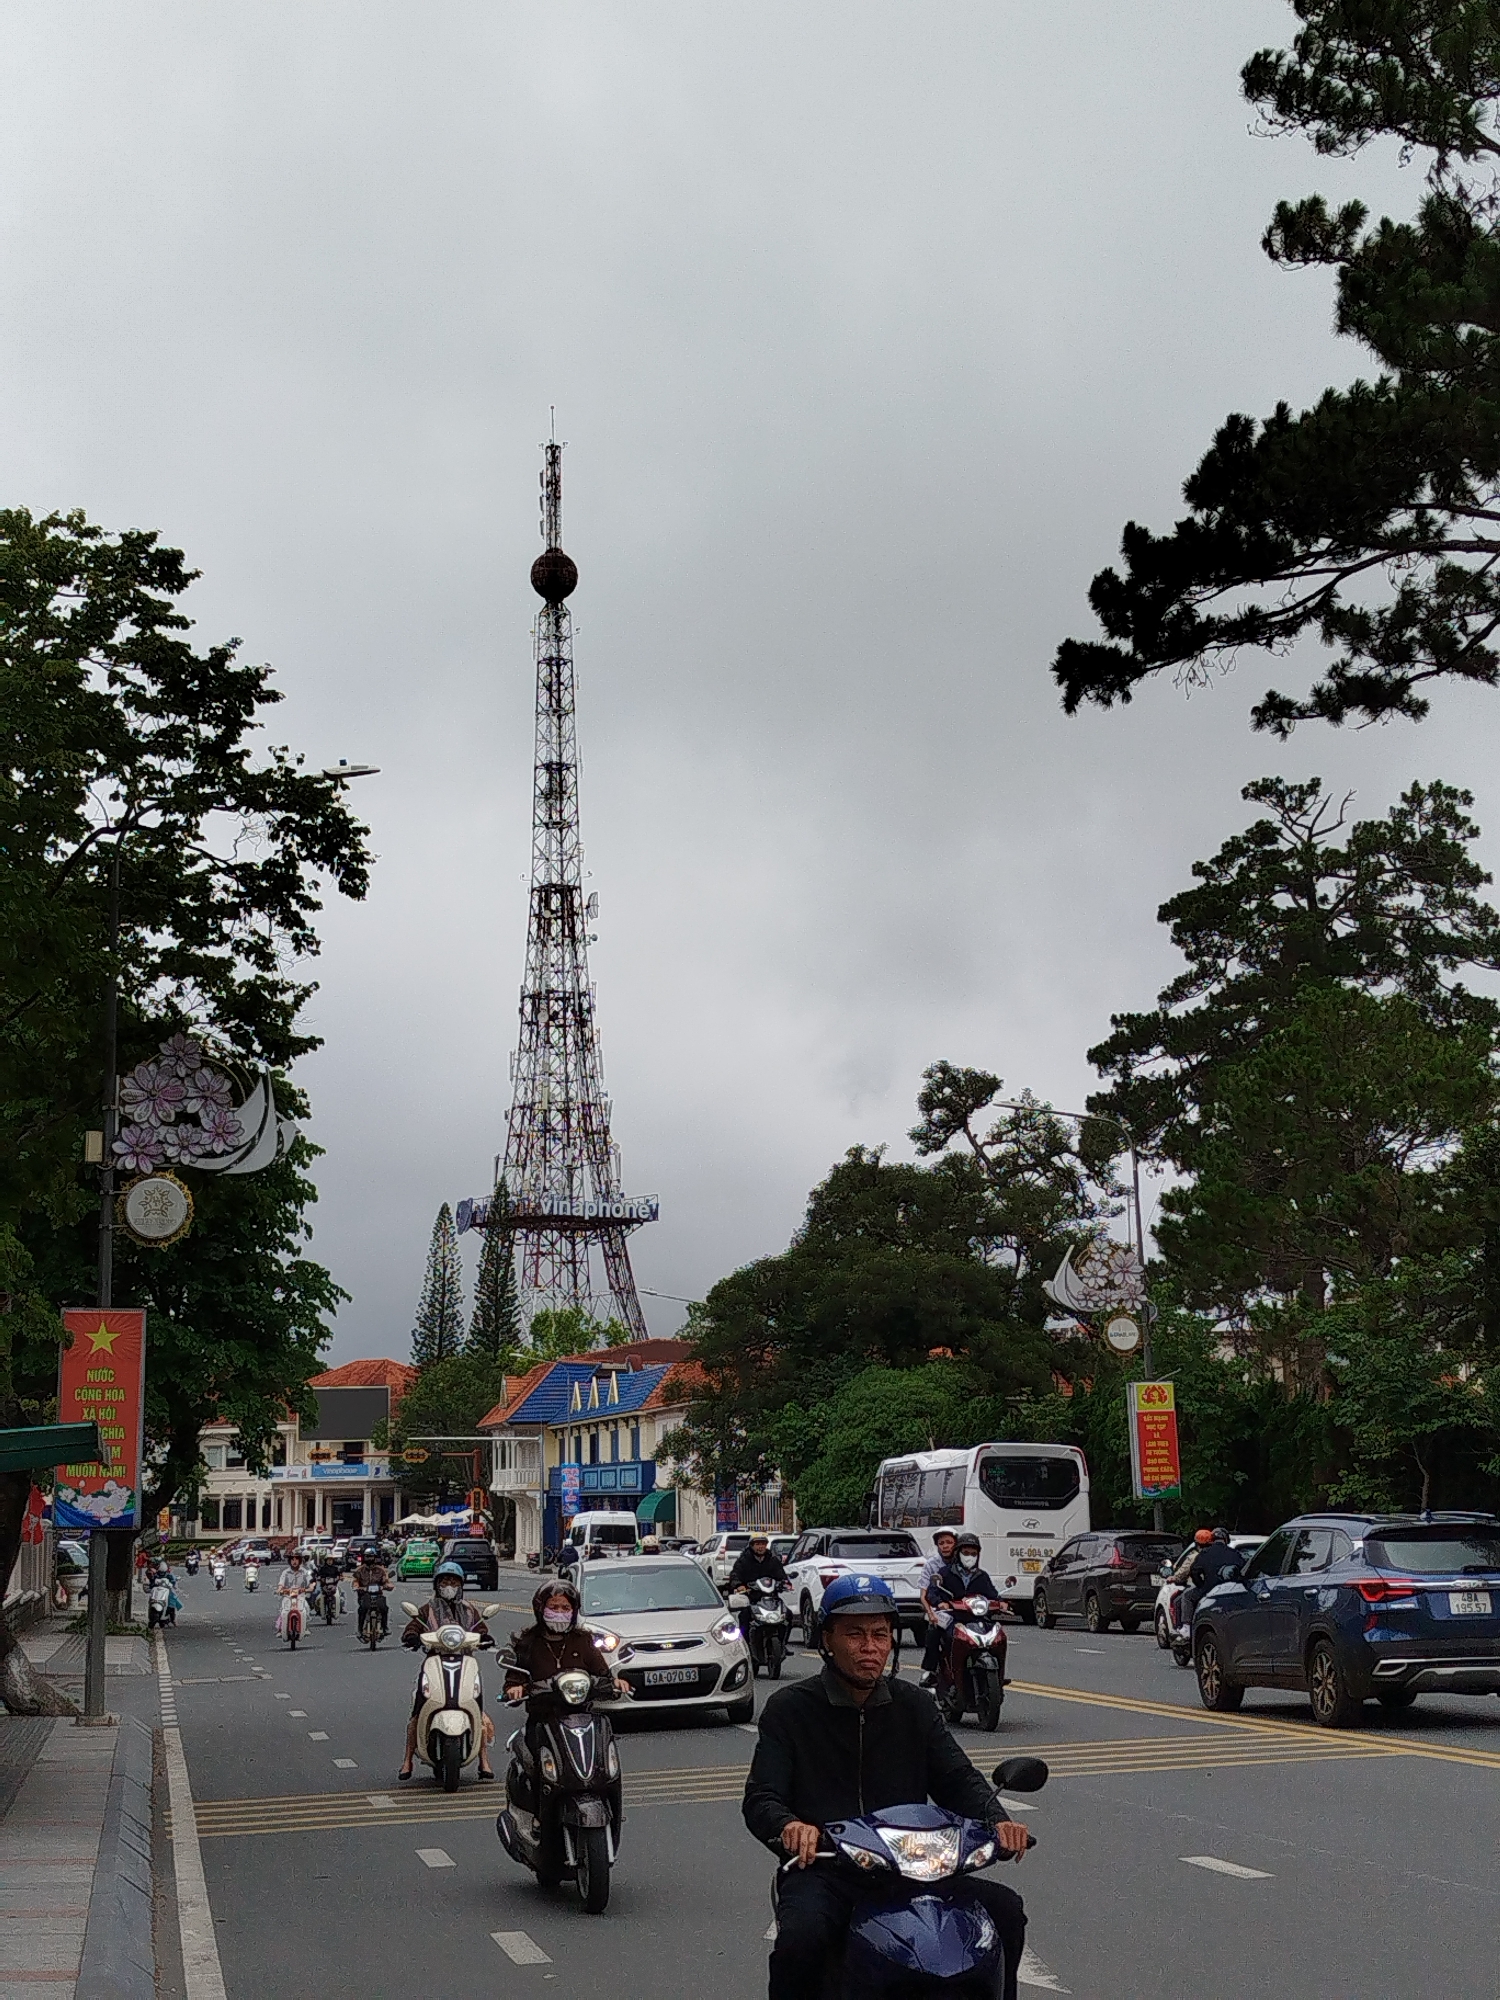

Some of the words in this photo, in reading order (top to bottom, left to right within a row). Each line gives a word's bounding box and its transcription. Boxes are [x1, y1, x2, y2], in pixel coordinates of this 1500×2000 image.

[541, 1197, 650, 1220] vinaphone
[86, 1367, 115, 1382] NƯỚC
[74, 1386, 102, 1404] CỘNG
[82, 1406, 97, 1420] XÃ
[98, 1405, 117, 1422] HỘI
[99, 1425, 126, 1439] GHĨA
[1461, 1592, 1479, 1602] 48A
[1456, 1602, 1487, 1612] 195.57
